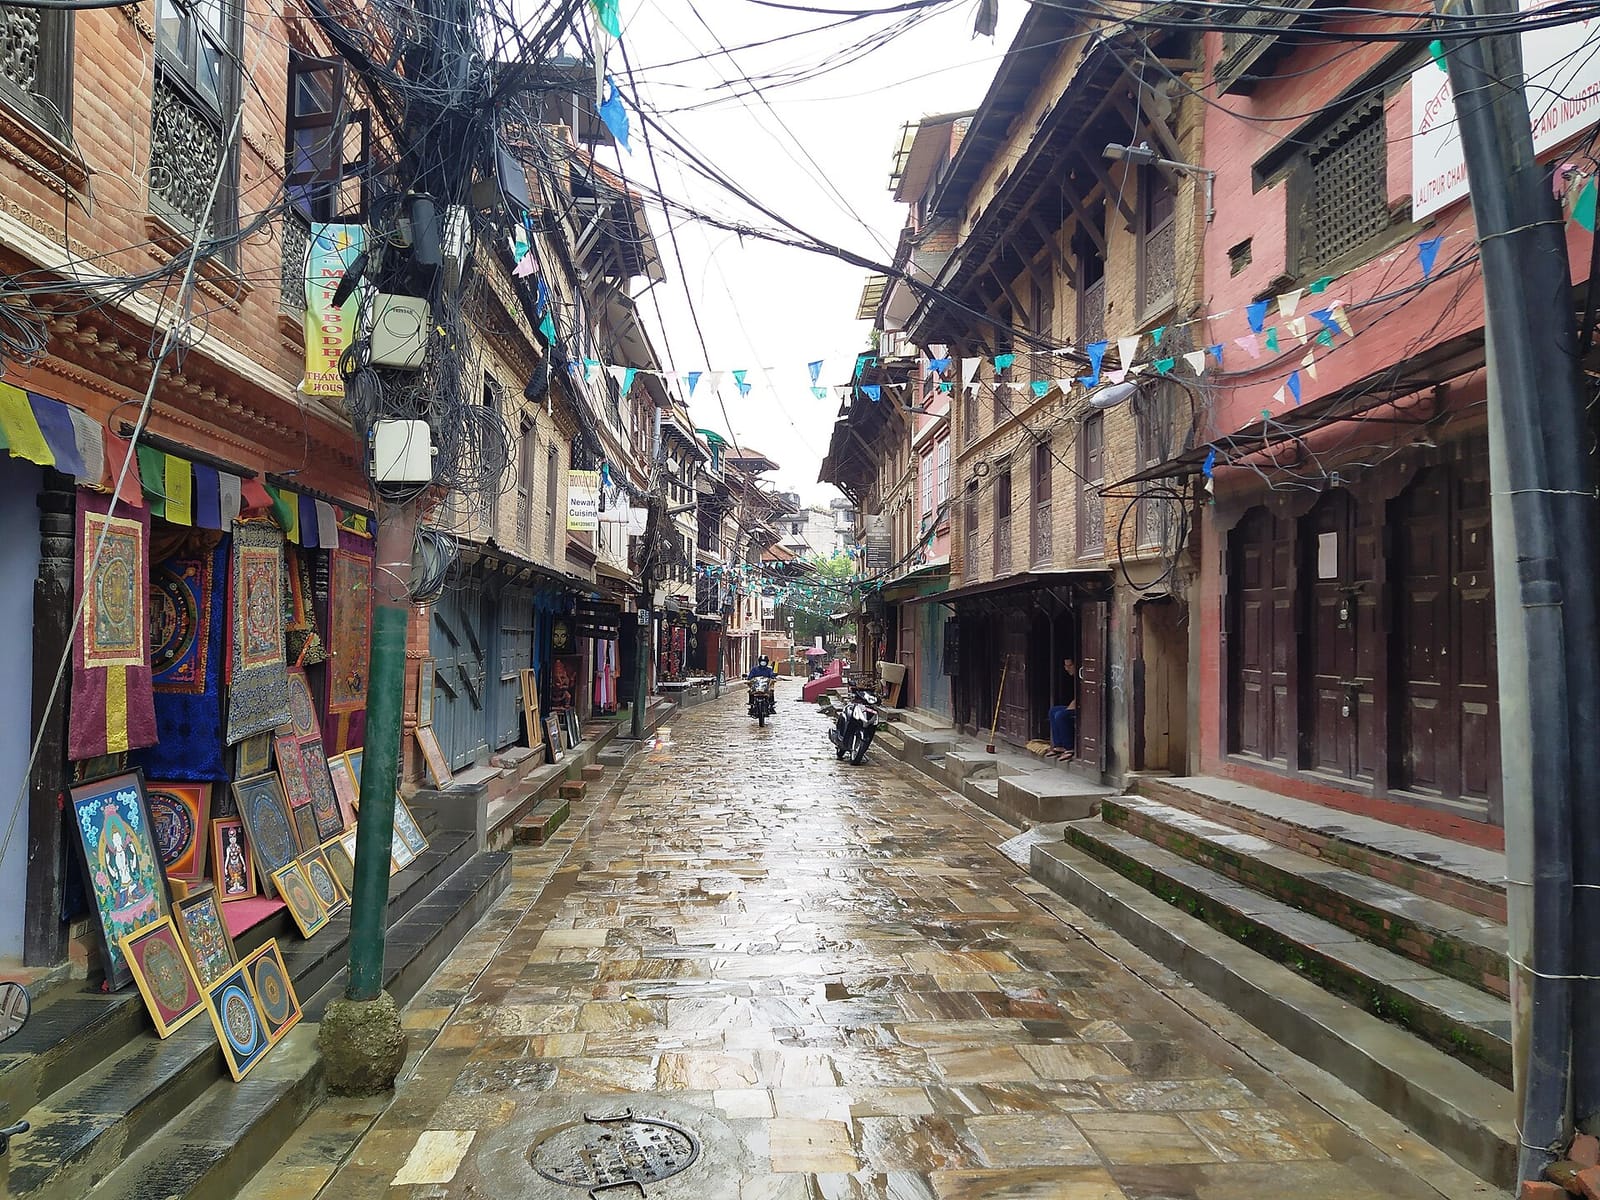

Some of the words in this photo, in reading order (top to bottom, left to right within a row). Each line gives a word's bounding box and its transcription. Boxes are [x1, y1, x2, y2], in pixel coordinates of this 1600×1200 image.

[1541, 107, 1558, 136] AND
[1416, 174, 1445, 207] LALITPUR
[570, 498, 595, 507] Newari
[569, 509, 597, 518] Cuisine
